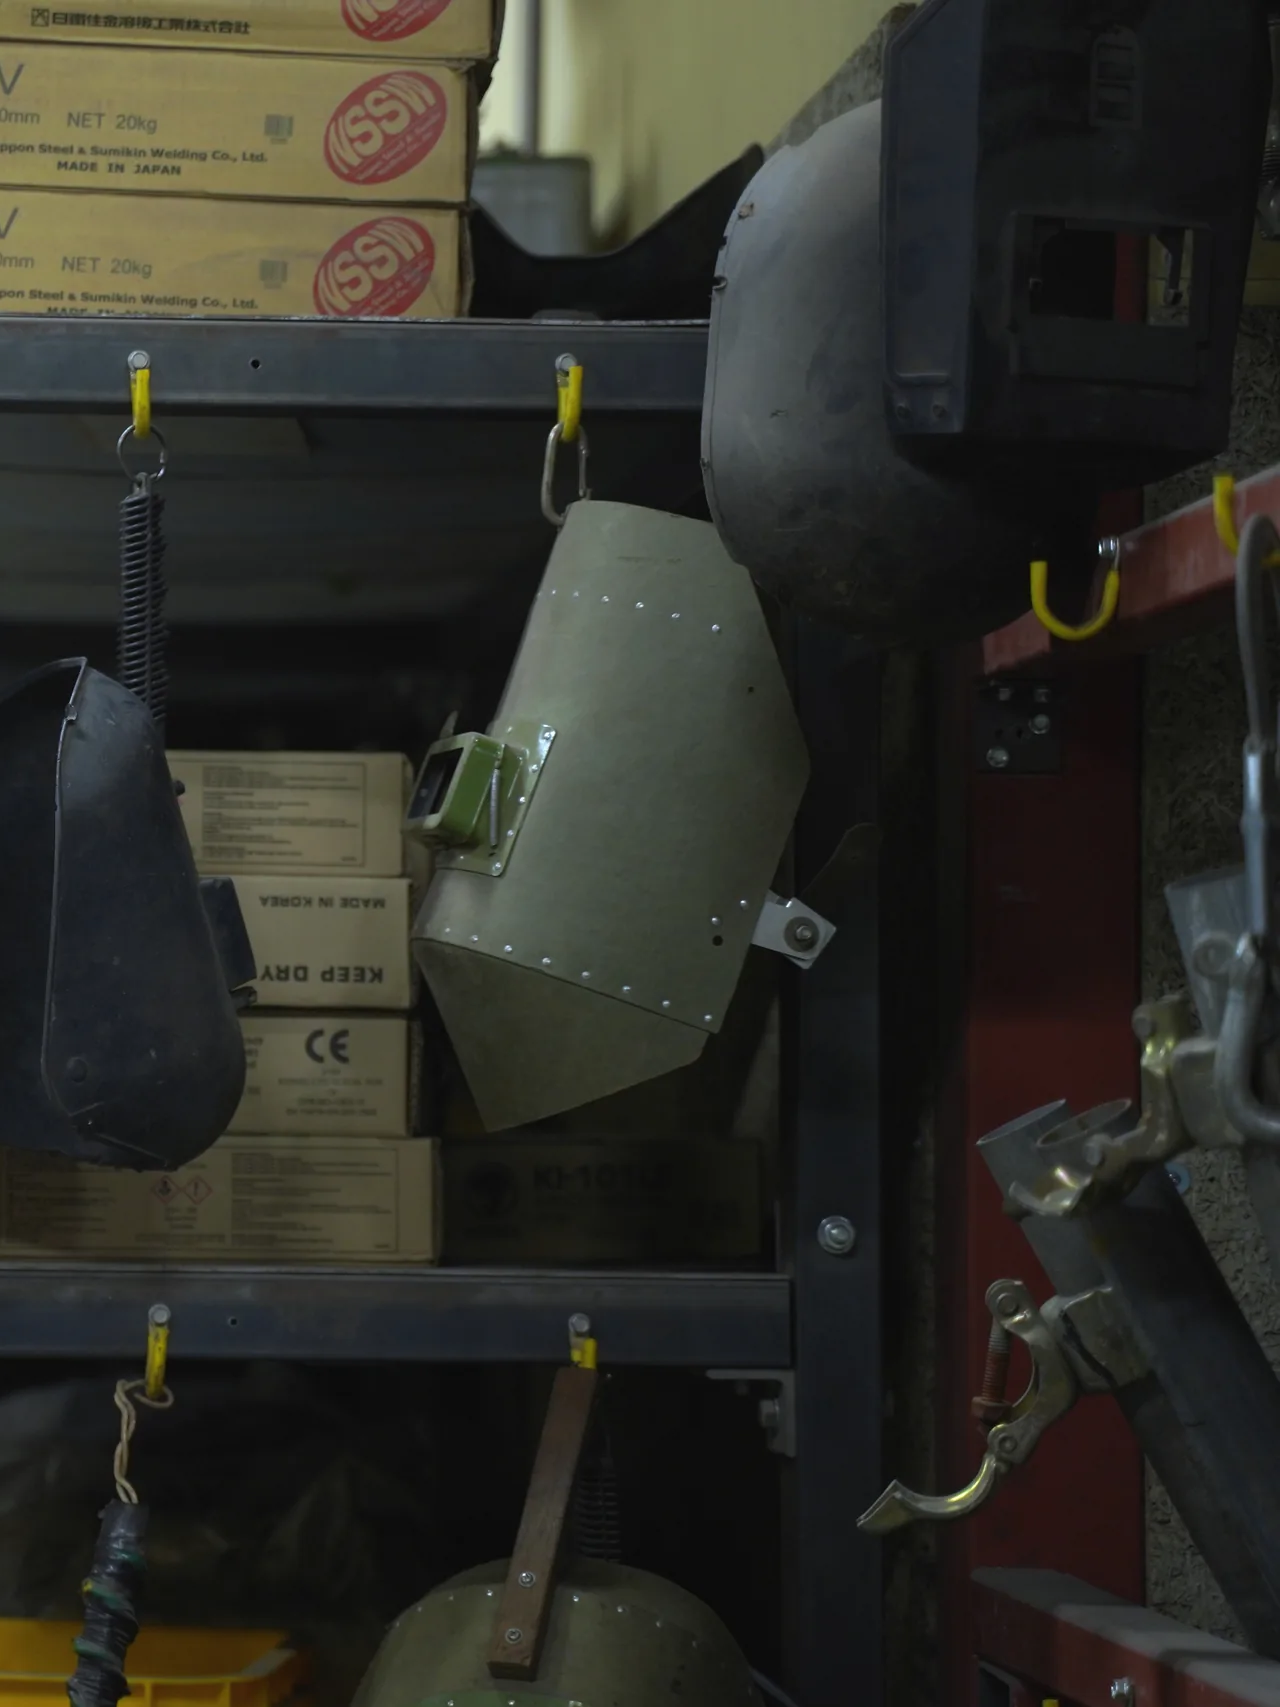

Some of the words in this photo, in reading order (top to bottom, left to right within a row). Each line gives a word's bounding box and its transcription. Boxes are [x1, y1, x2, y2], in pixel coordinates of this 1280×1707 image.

[67, 112, 106, 129] NET
[115, 115, 158, 135] 20kg
[39, 143, 74, 155] Steel
[77, 147, 86, 156] &
[90, 145, 147, 158] Sumikin
[151, 148, 208, 162] Welding
[212, 150, 238, 163] Co.,
[242, 151, 268, 163] Ltd.
[57, 161, 98, 173] MADE
[108, 162, 124, 173] IN
[134, 164, 181, 176] JAPAN
[61, 256, 101, 273] NET
[110, 259, 152, 279] 20kg
[29, 289, 64, 301] Steel
[80, 291, 136, 304] Sumikin
[140, 294, 197, 309] Welding
[232, 298, 258, 310] Ltd.
[259, 895, 312, 908] KOREA
[318, 896, 334, 908] IN
[340, 897, 386, 909] MADE
[260, 964, 308, 982] DRY
[320, 965, 383, 983] KEEP
